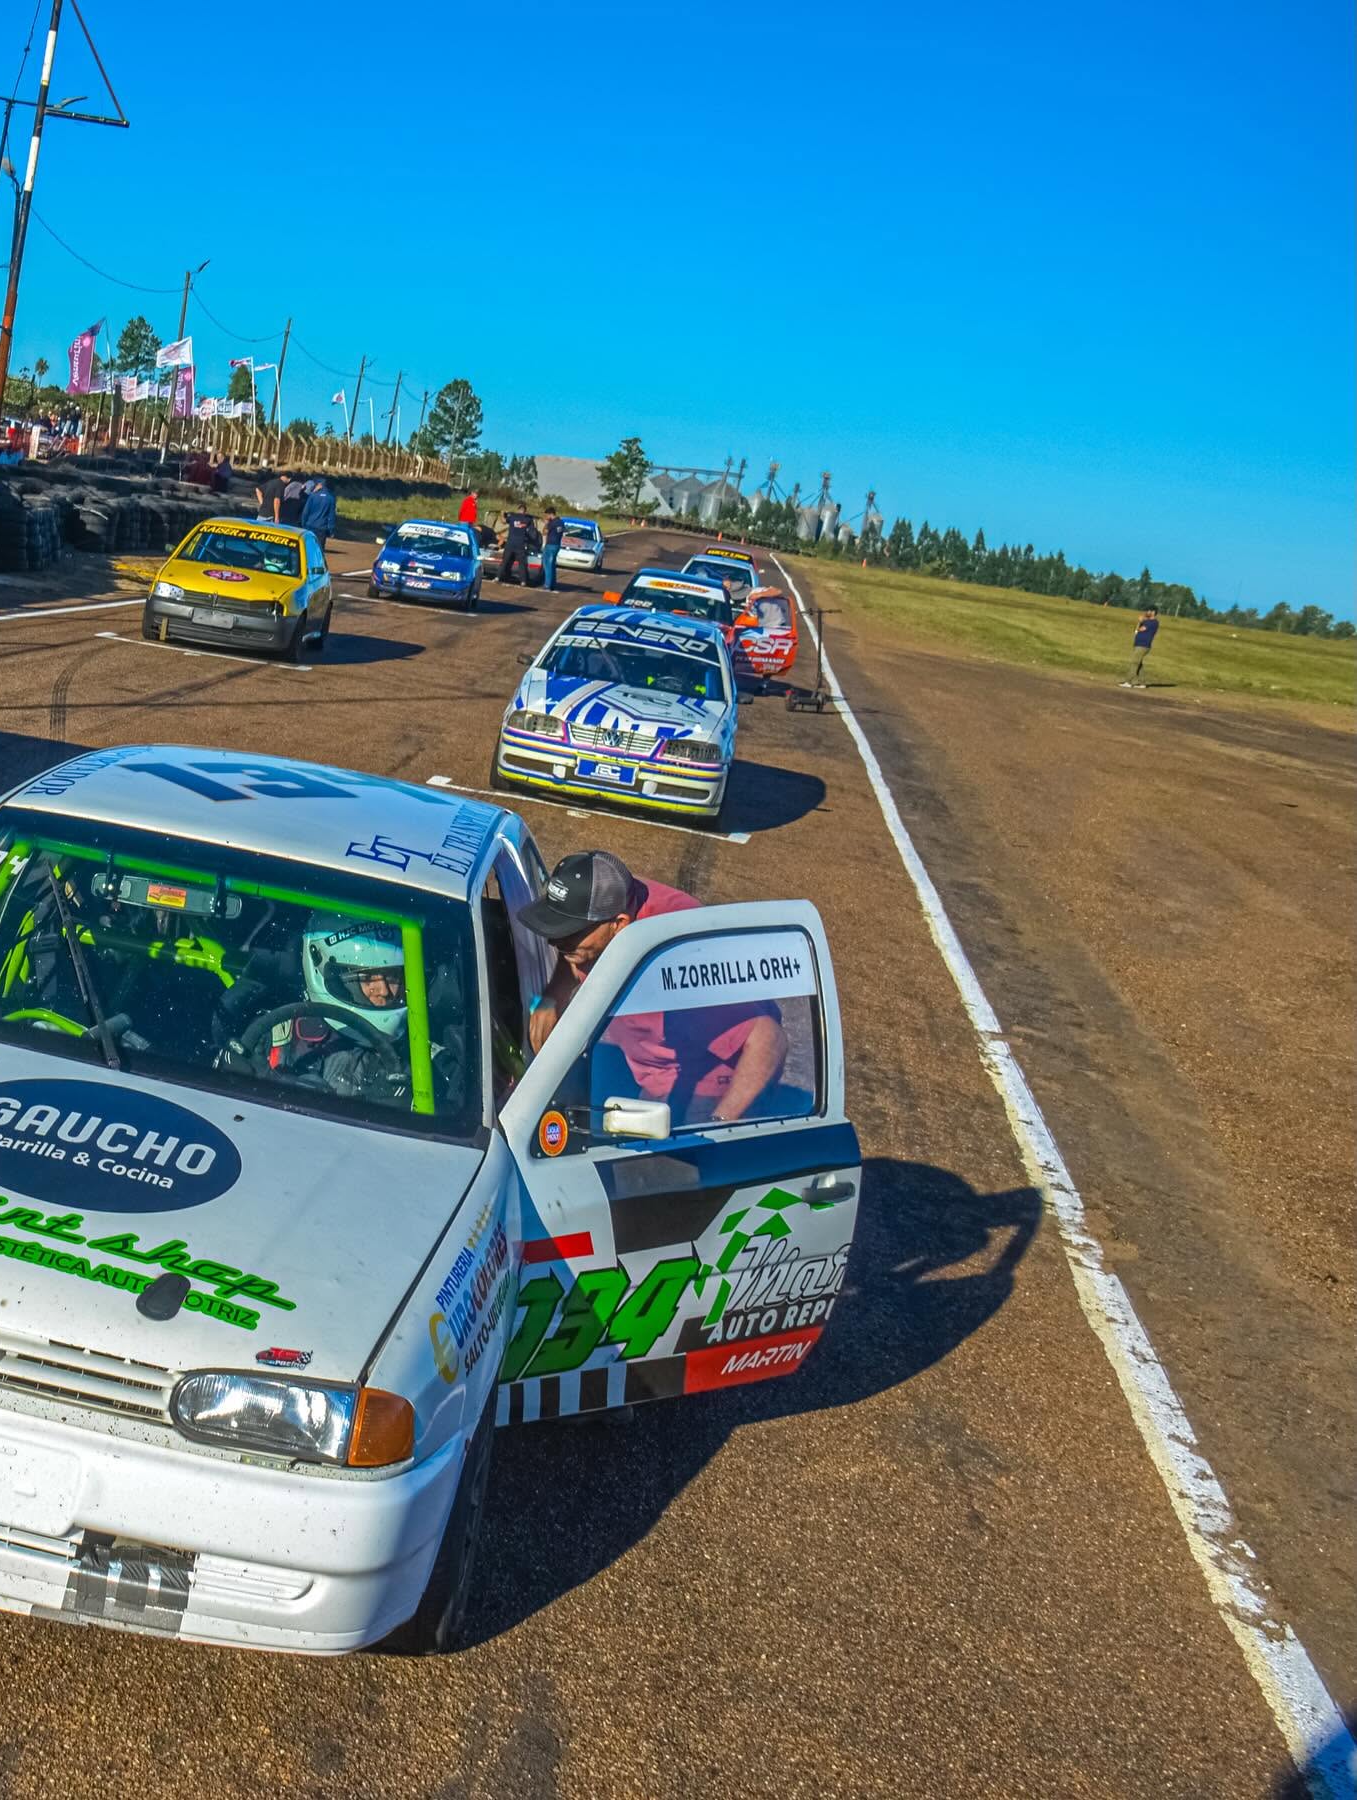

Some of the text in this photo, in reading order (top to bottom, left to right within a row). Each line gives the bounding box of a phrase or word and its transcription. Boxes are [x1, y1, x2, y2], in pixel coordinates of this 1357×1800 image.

[200, 525, 239, 537] KAISER
[249, 532, 290, 545] KAISER
[573, 621, 709, 653] SEVERO
[739, 636, 794, 655] CSR
[759, 956, 801, 980] ORH+
[72, 1151, 92, 1168] &
[97, 1158, 175, 1190] Cocina
[87, 1232, 297, 1311] shop
[435, 1247, 476, 1313] PINTURERIA
[498, 1255, 702, 1383] 134
[706, 1309, 778, 1345] AUTO
[720, 1340, 812, 1376] MARTIN
